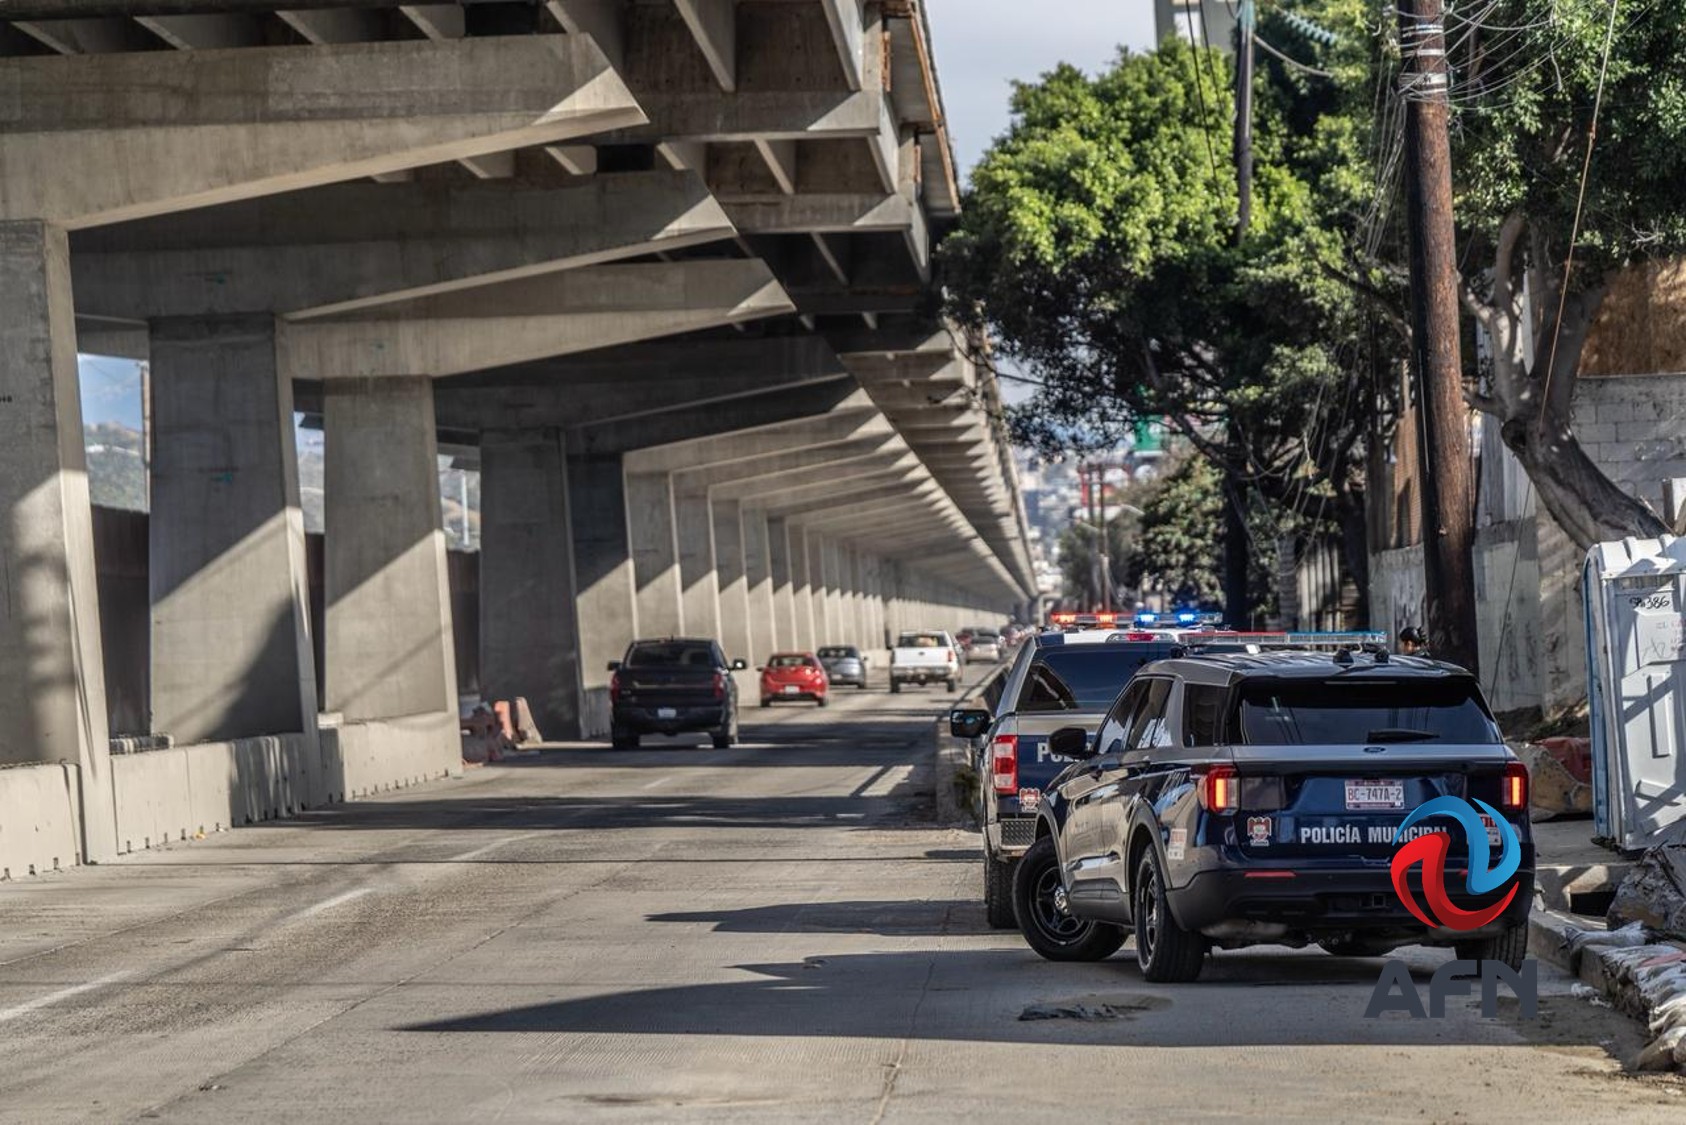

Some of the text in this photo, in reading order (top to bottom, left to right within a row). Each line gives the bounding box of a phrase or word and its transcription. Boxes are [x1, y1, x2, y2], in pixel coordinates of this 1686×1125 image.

[1347, 787, 1402, 801] BC-747A-2
[1300, 823, 1447, 844] POLICÍA MUNICI
